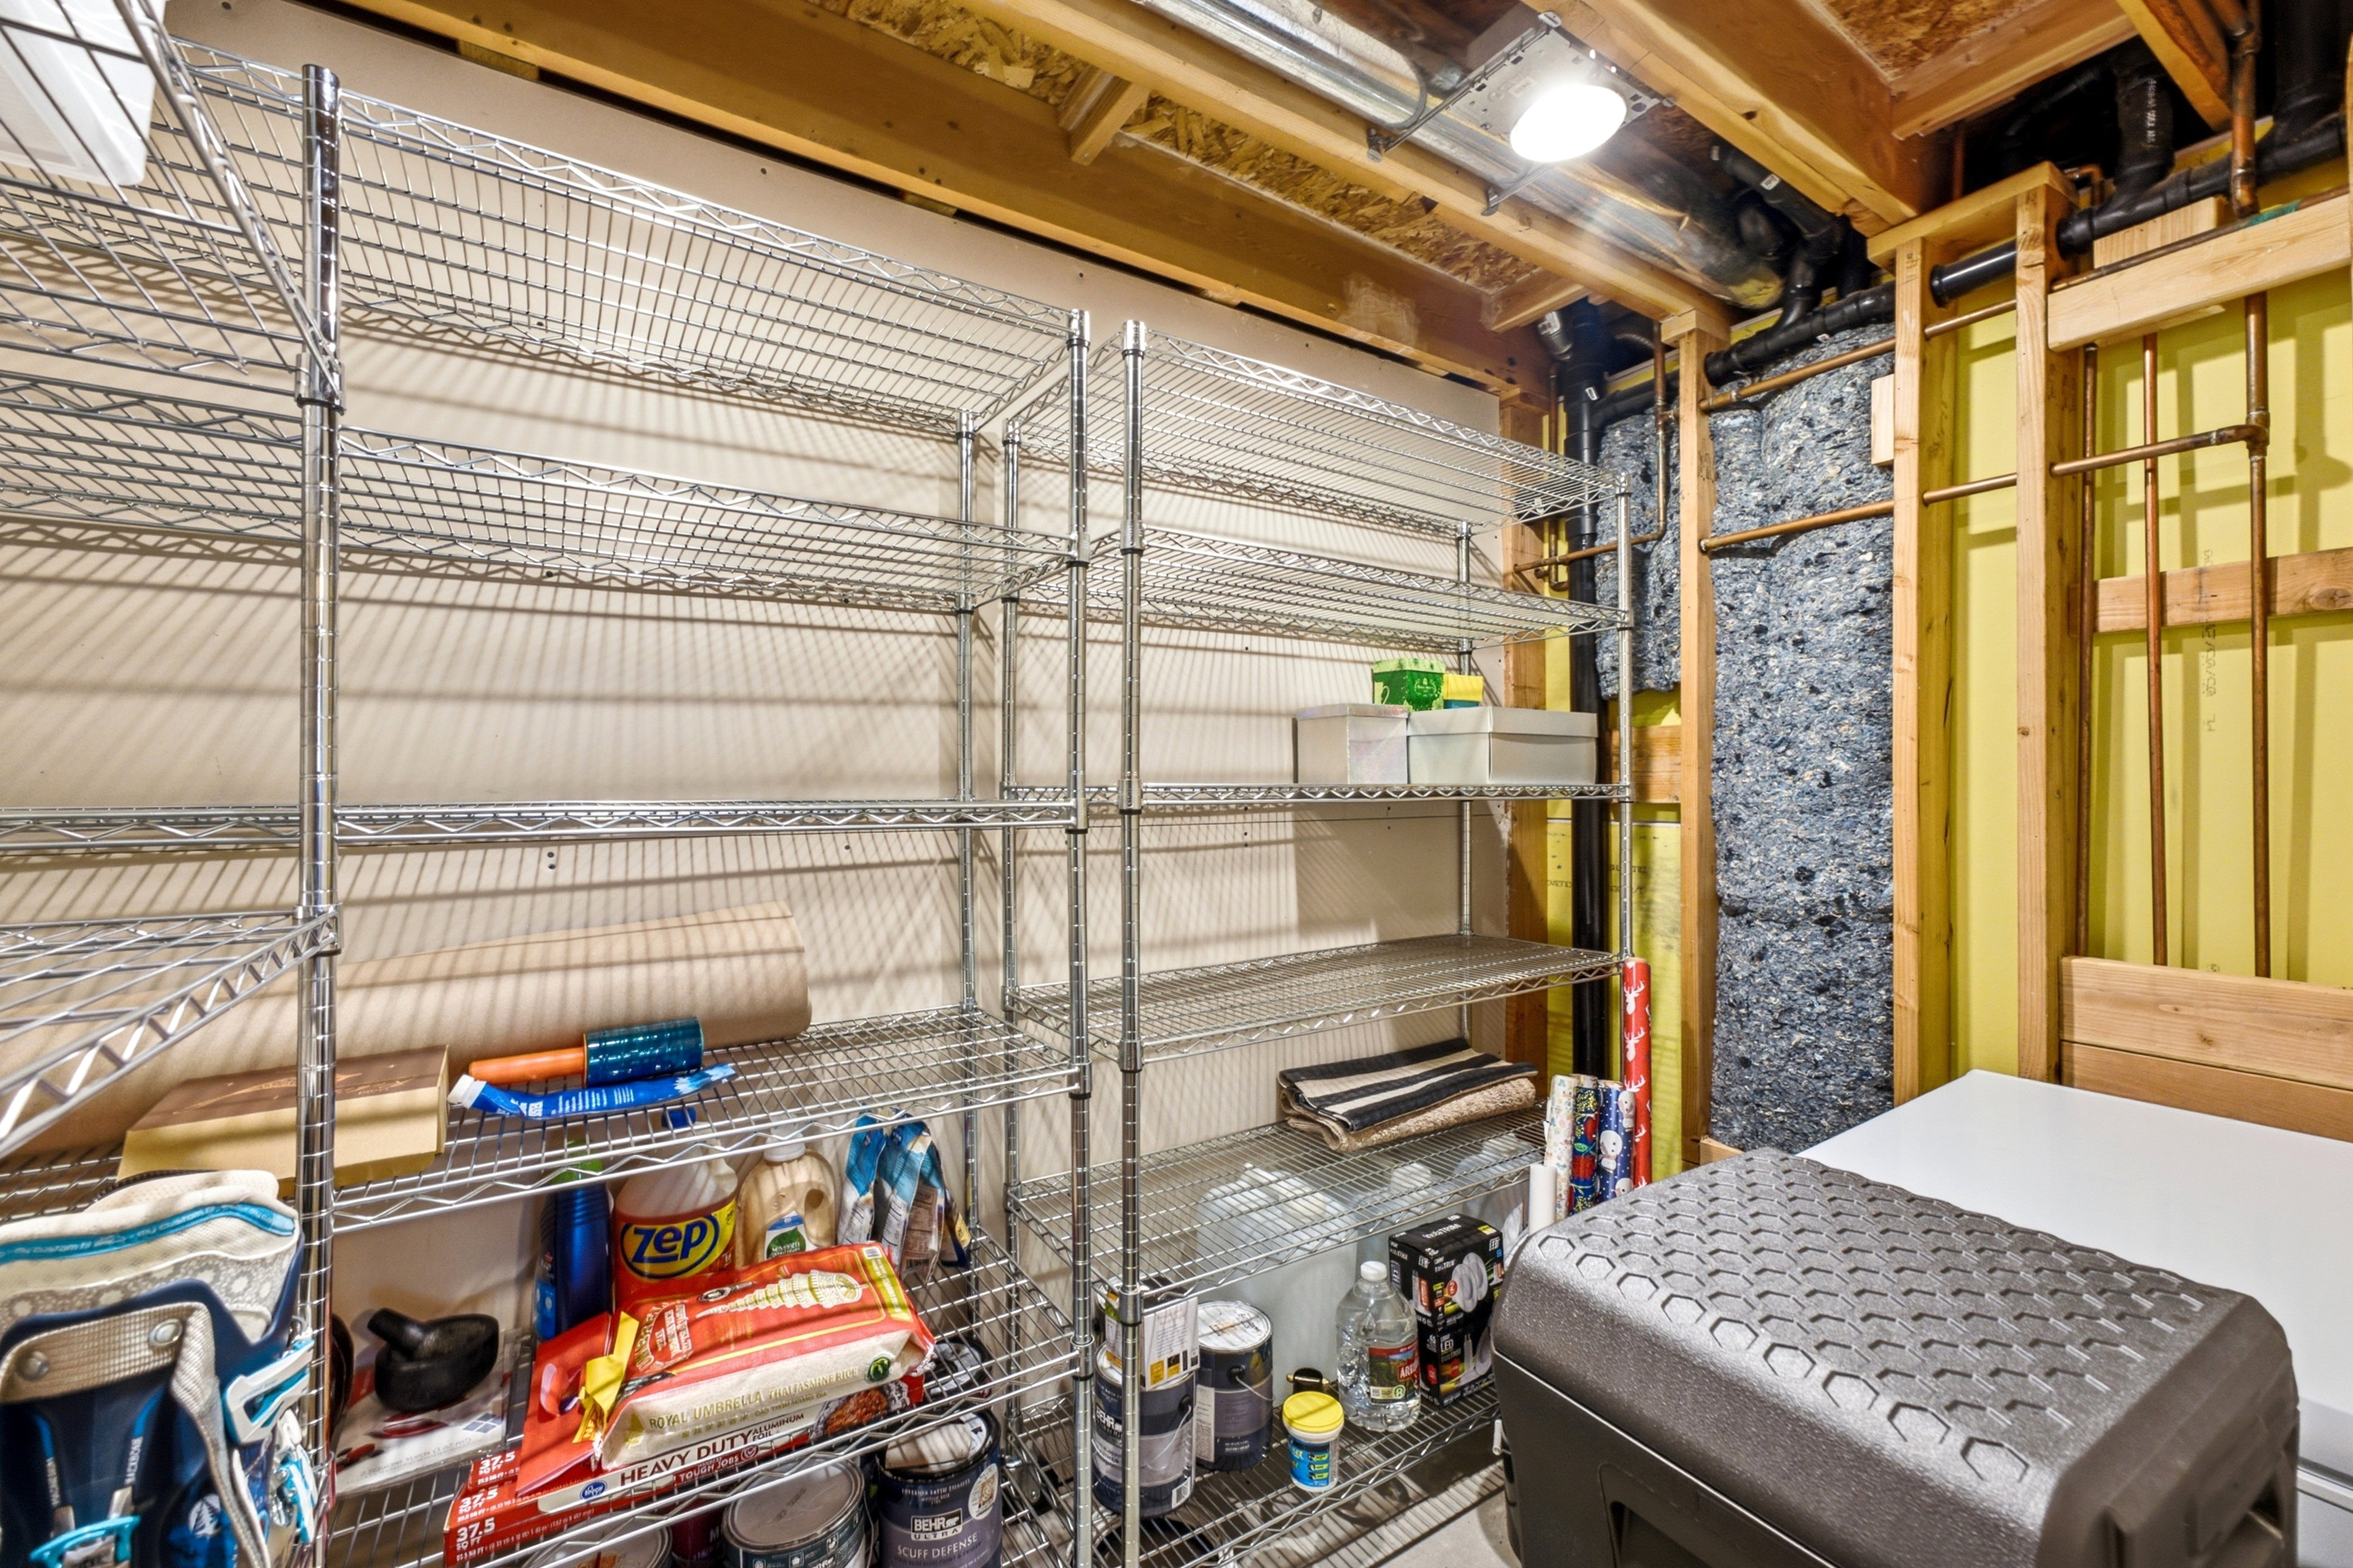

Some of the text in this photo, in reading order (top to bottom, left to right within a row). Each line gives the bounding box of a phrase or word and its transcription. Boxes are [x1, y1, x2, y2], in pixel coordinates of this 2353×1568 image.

[649, 1414, 687, 1429] ROYAL
[693, 1391, 765, 1420] UMBRELLA
[752, 1413, 804, 1435] ALUMINUM
[752, 1430, 773, 1442] FOIL
[480, 1451, 516, 1468] 37.5
[620, 1430, 755, 1486] HEAVY DUTY
[679, 1464, 715, 1481] TOUGH
[460, 1488, 498, 1507] 37.5
[457, 1517, 495, 1541] 37.5
[913, 1528, 959, 1540] ULTRA
[914, 1517, 946, 1532] BEHR
[898, 1544, 928, 1559] SCUFF
[932, 1532, 978, 1558] DEFENSE
